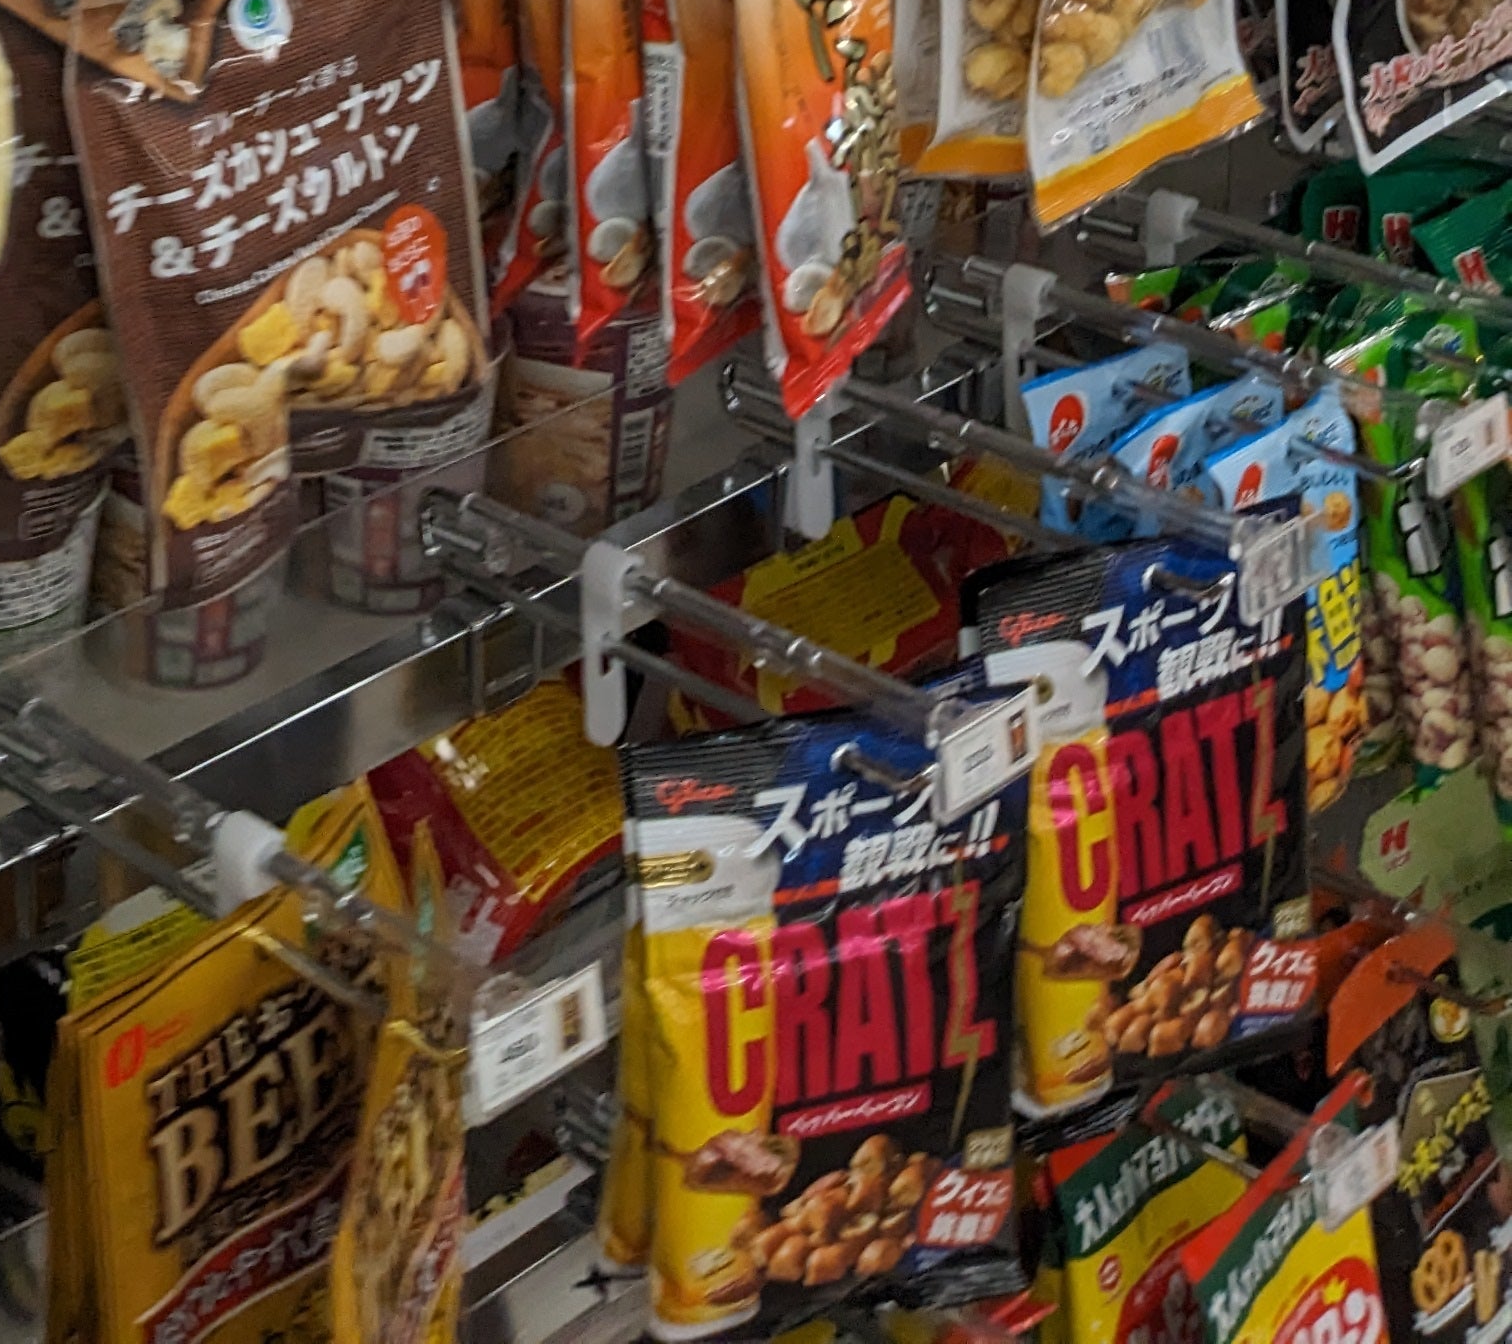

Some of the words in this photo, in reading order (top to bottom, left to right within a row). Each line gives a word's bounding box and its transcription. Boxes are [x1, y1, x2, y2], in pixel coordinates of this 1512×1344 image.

[105, 56, 444, 234] チーズカシューナッツ
[1046, 678, 1288, 915] CRATZ
[700, 882, 996, 1120] CRATZ
